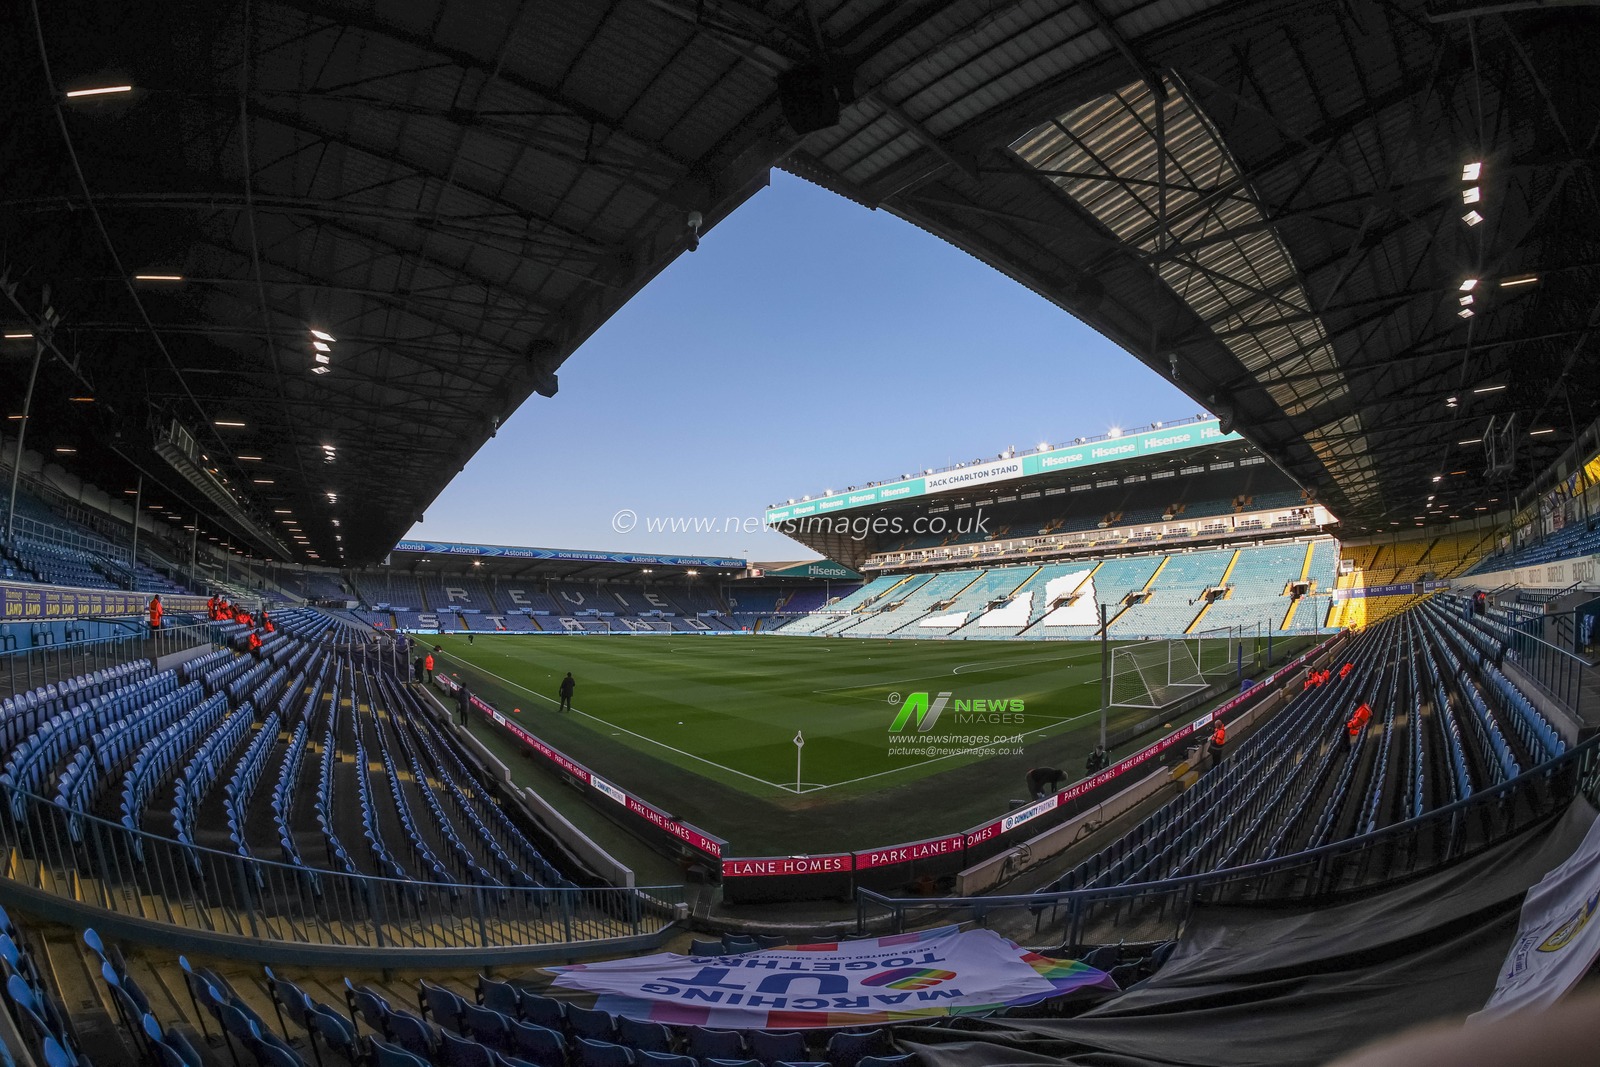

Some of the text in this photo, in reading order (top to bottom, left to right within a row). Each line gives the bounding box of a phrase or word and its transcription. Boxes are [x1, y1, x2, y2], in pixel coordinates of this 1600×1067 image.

[1201, 428, 1221, 439] His
[1145, 433, 1190, 449] Hisense
[1092, 444, 1135, 458] Hisense
[1042, 452, 1083, 467] Hisense
[929, 464, 1019, 488] JACK CHARLTON STAND
[881, 486, 910, 498] Hisense
[820, 499, 843, 509] Hisense
[849, 493, 875, 504] Hisense
[793, 505, 815, 515] Hisense
[395, 542, 426, 551] Astonish
[450, 546, 480, 554] Astonish
[504, 549, 533, 557] Astonish
[808, 565, 846, 576] Hisense
[446, 587, 668, 607] REVIE
[5, 602, 22, 615] LAND
[25, 603, 40, 615] LAND
[46, 604, 60, 615] LAND
[62, 604, 74, 615] LAND
[1121, 746, 1158, 772] PARK LANE HOMES
[1064, 769, 1115, 801] PARK LANE HOMES
[630, 800, 690, 840] PARK LANE HOMES
[871, 849, 907, 865] PARK
[913, 842, 947, 857] LANE
[734, 858, 841, 874] LANE HOMES
[690, 953, 946, 970] TOGETH
[856, 952, 898, 960] UNITED
[640, 983, 966, 1010] MARCHING
